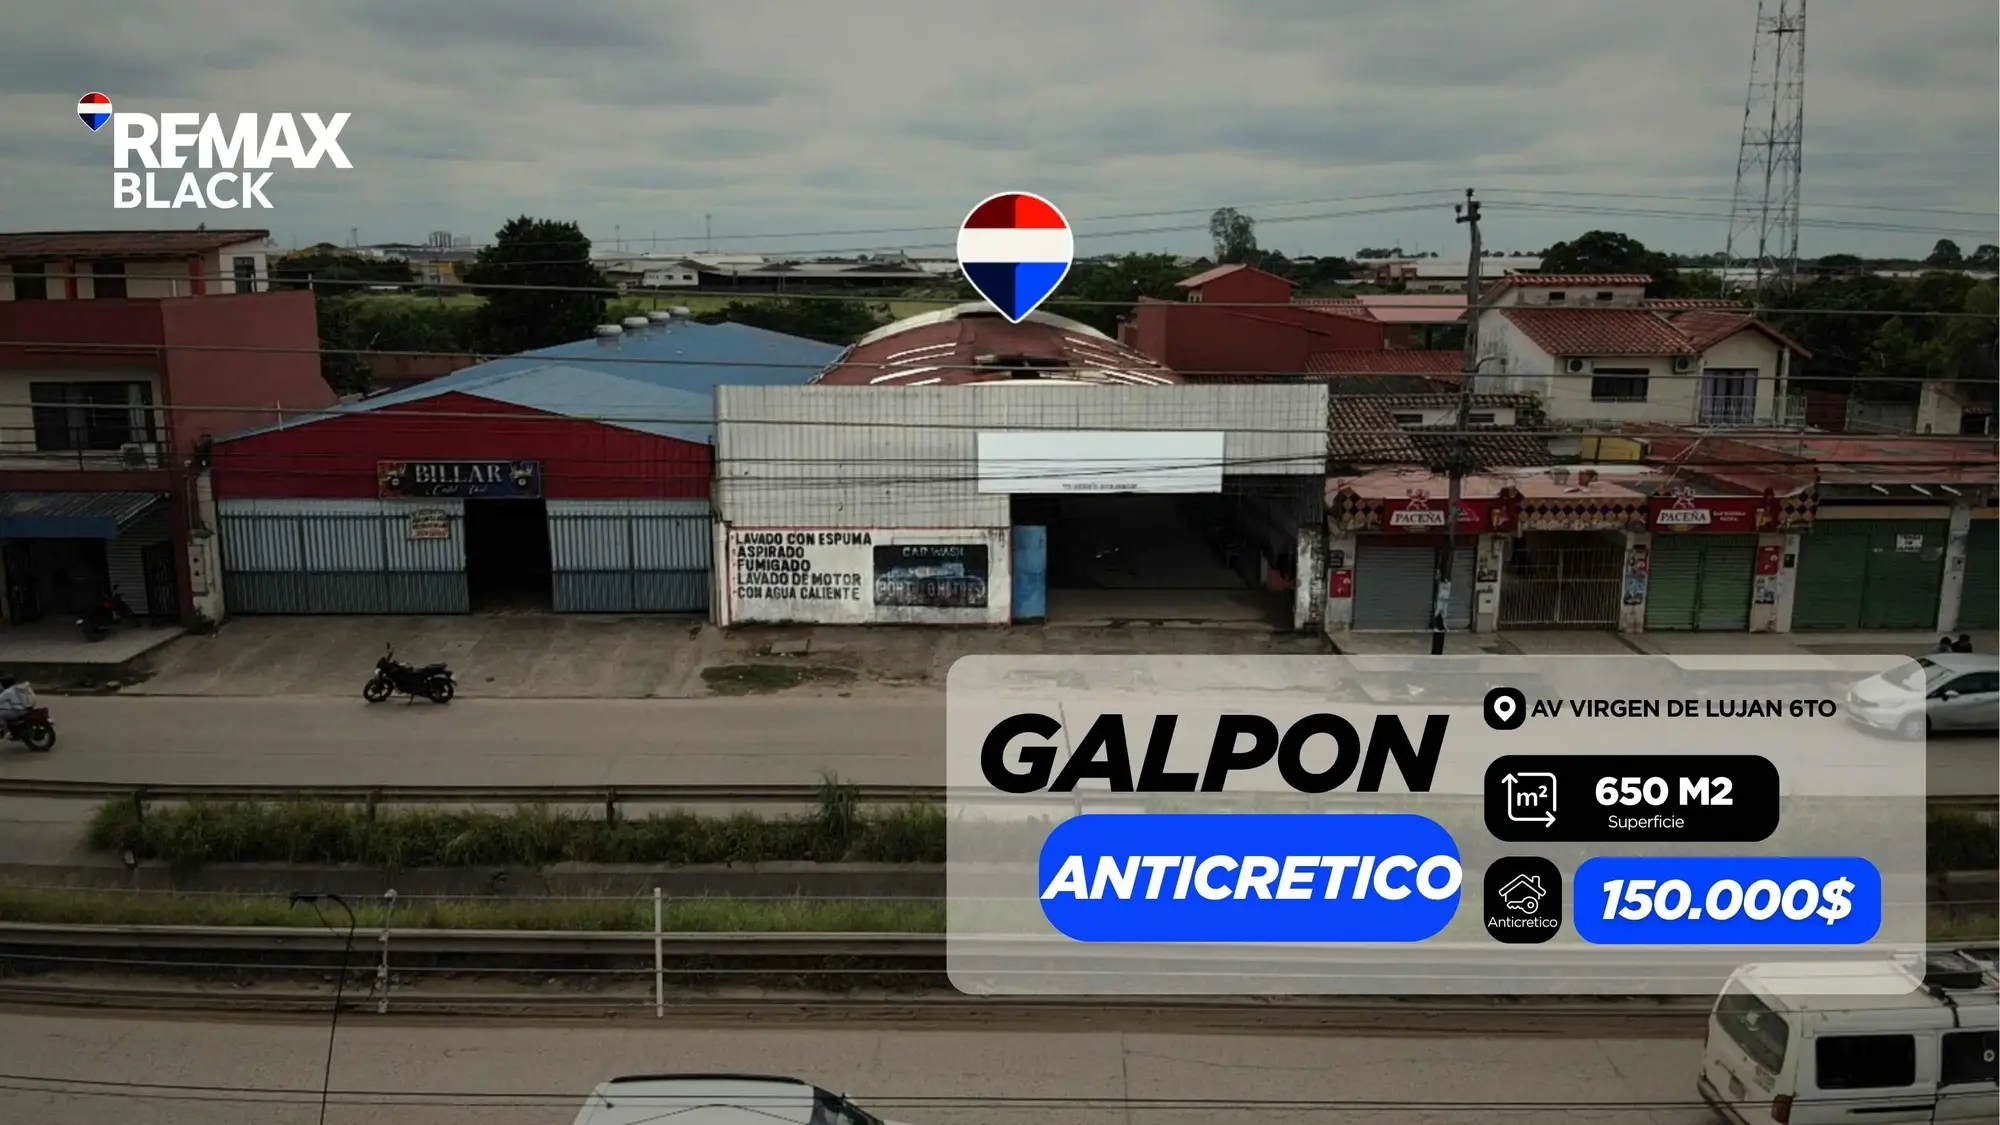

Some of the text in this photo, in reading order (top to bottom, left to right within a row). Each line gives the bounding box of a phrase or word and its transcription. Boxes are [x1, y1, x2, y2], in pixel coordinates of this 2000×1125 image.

[415, 464, 503, 483] BILLAR
[1395, 510, 1443, 524] PACEÑA
[1660, 510, 1707, 523] PACEÑA
[735, 532, 872, 545] LAVADO CON ESPUMA
[737, 546, 805, 558] ASPIRADO
[931, 547, 965, 557] WASH
[737, 559, 811, 572] FUMIGADO
[737, 572, 862, 586] LAVADO DE MOTOR
[737, 587, 861, 600] CON AGUA CALIENTE
